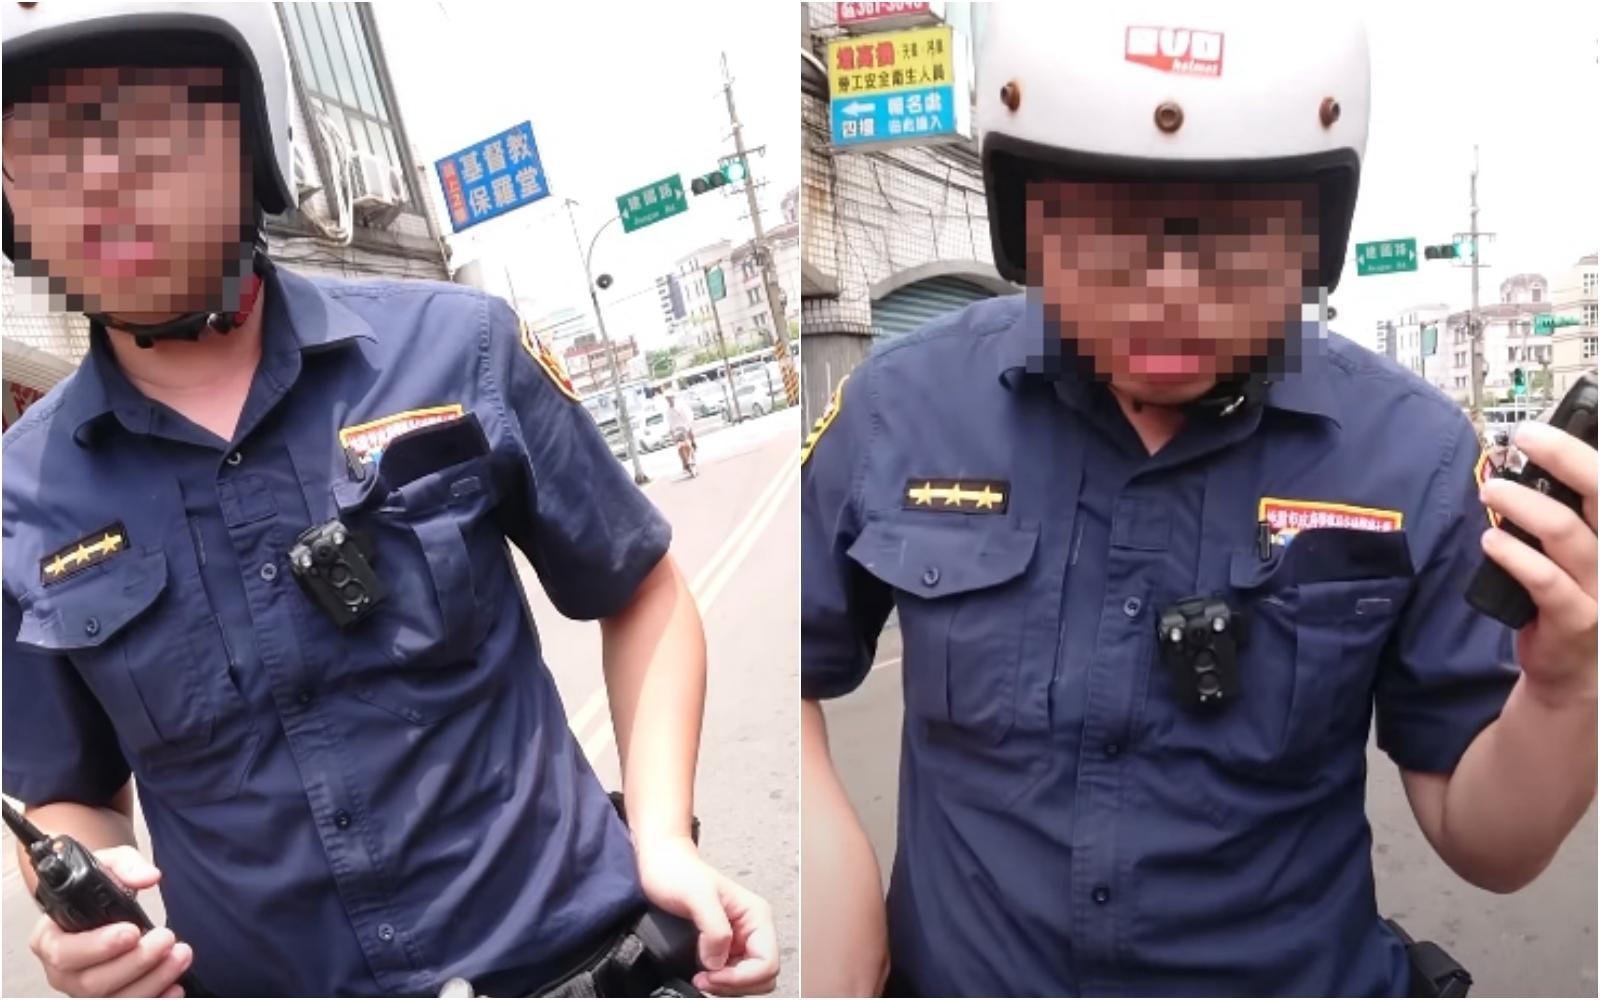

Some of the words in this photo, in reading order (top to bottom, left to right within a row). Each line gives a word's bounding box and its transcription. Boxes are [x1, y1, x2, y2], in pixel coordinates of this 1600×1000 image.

[459, 132, 532, 184] 基督教
[468, 166, 541, 217] 保羅堂
